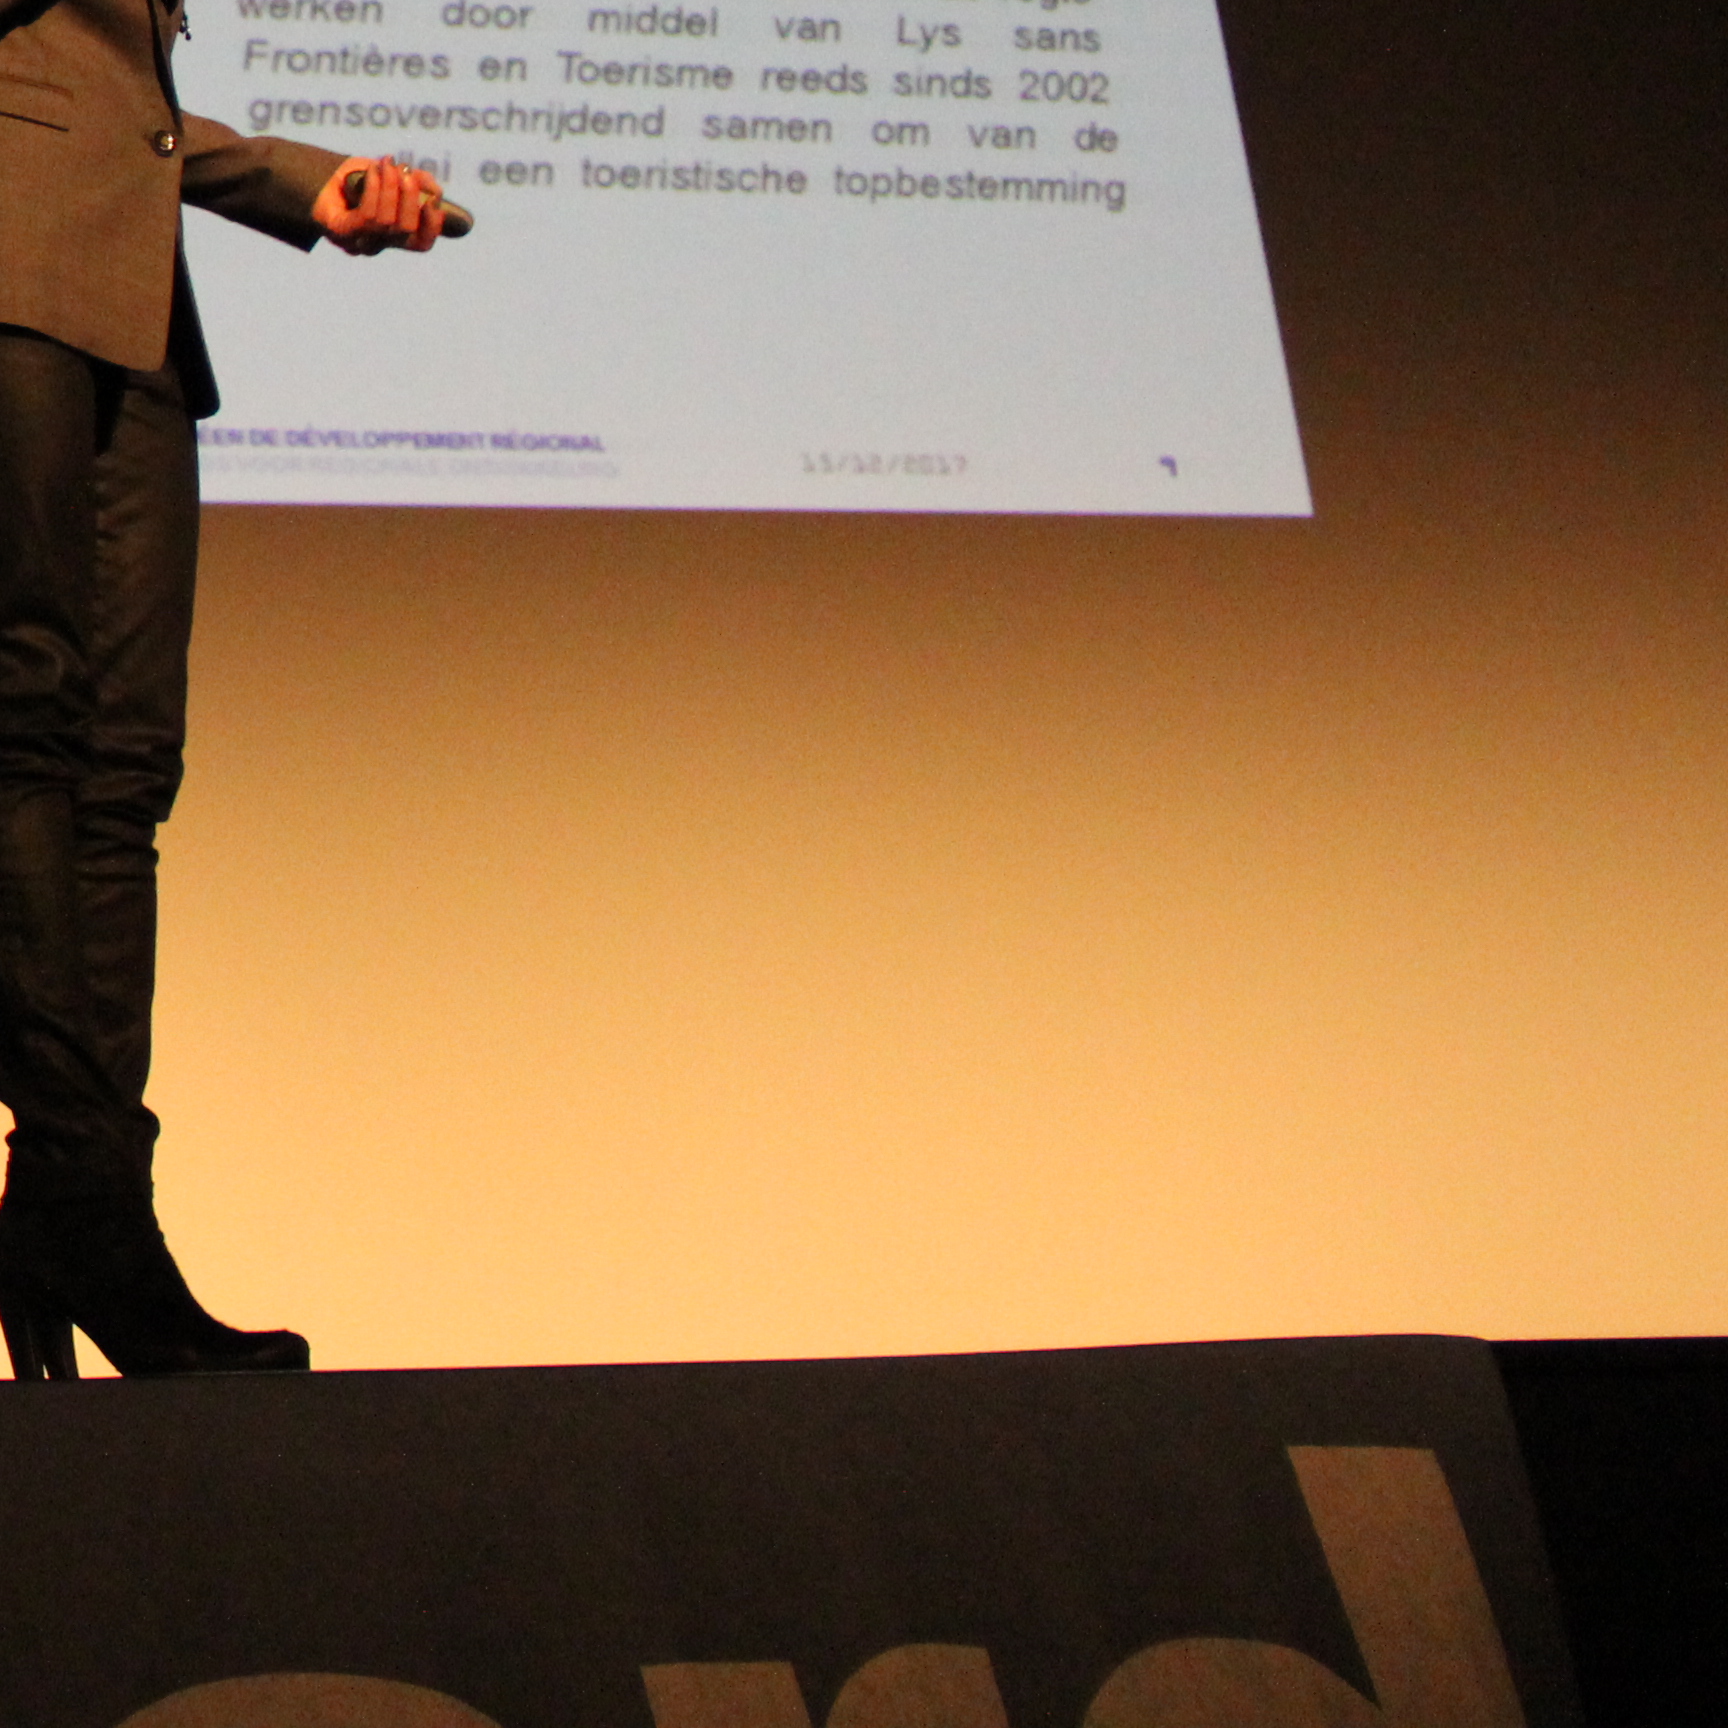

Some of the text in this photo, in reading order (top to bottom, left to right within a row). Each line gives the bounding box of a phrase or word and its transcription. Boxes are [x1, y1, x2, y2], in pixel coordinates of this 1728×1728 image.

[587, 5, 718, 37] middel
[774, 16, 841, 42] van
[897, 12, 962, 53] Lys
[1014, 25, 1100, 53] sans
[244, 39, 1109, 104] Frontières en Toerisme reeds sinds 2002
[249, 98, 1118, 152] grensoverschrijdend samen om van de
[479, 160, 553, 185] een
[582, 158, 807, 195] toeristische
[834, 166, 1126, 212] topbestemming
